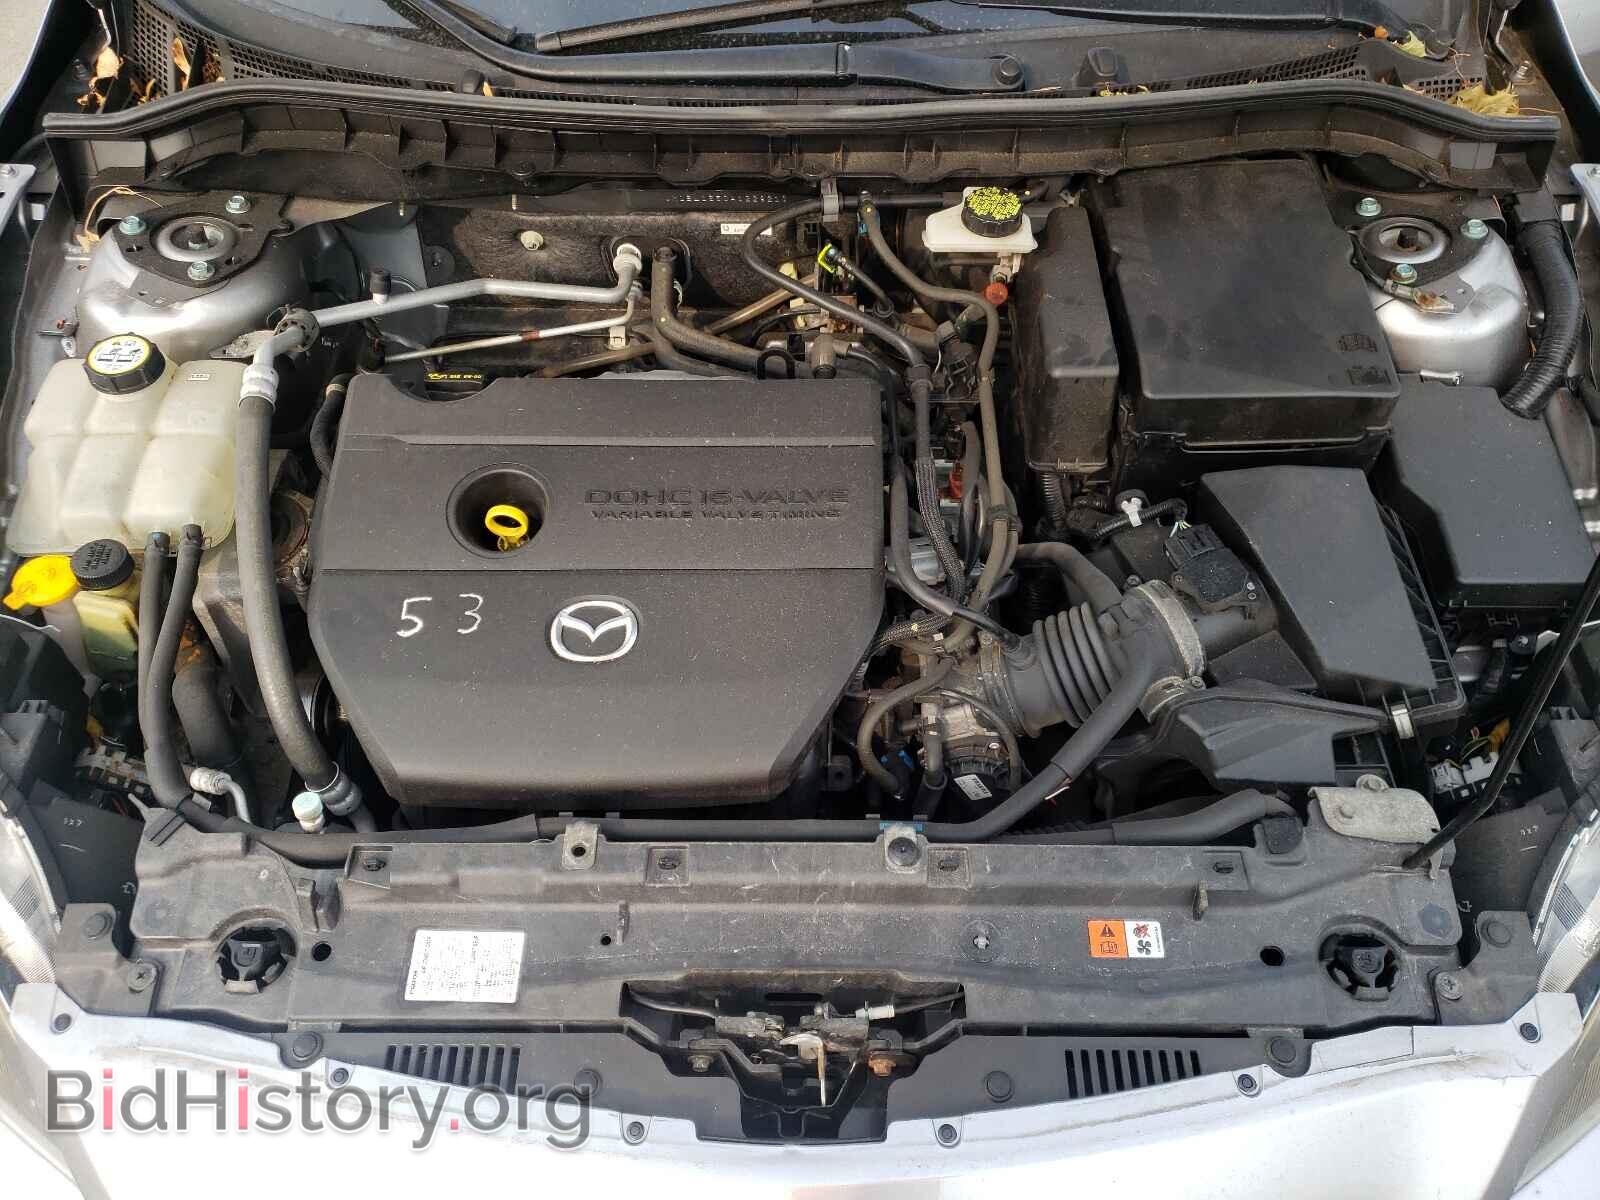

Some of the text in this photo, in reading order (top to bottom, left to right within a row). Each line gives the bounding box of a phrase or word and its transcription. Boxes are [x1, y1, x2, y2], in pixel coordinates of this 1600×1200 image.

[584, 489, 691, 506] DOHC
[591, 510, 841, 520] VARIABLE VALVE TIMING
